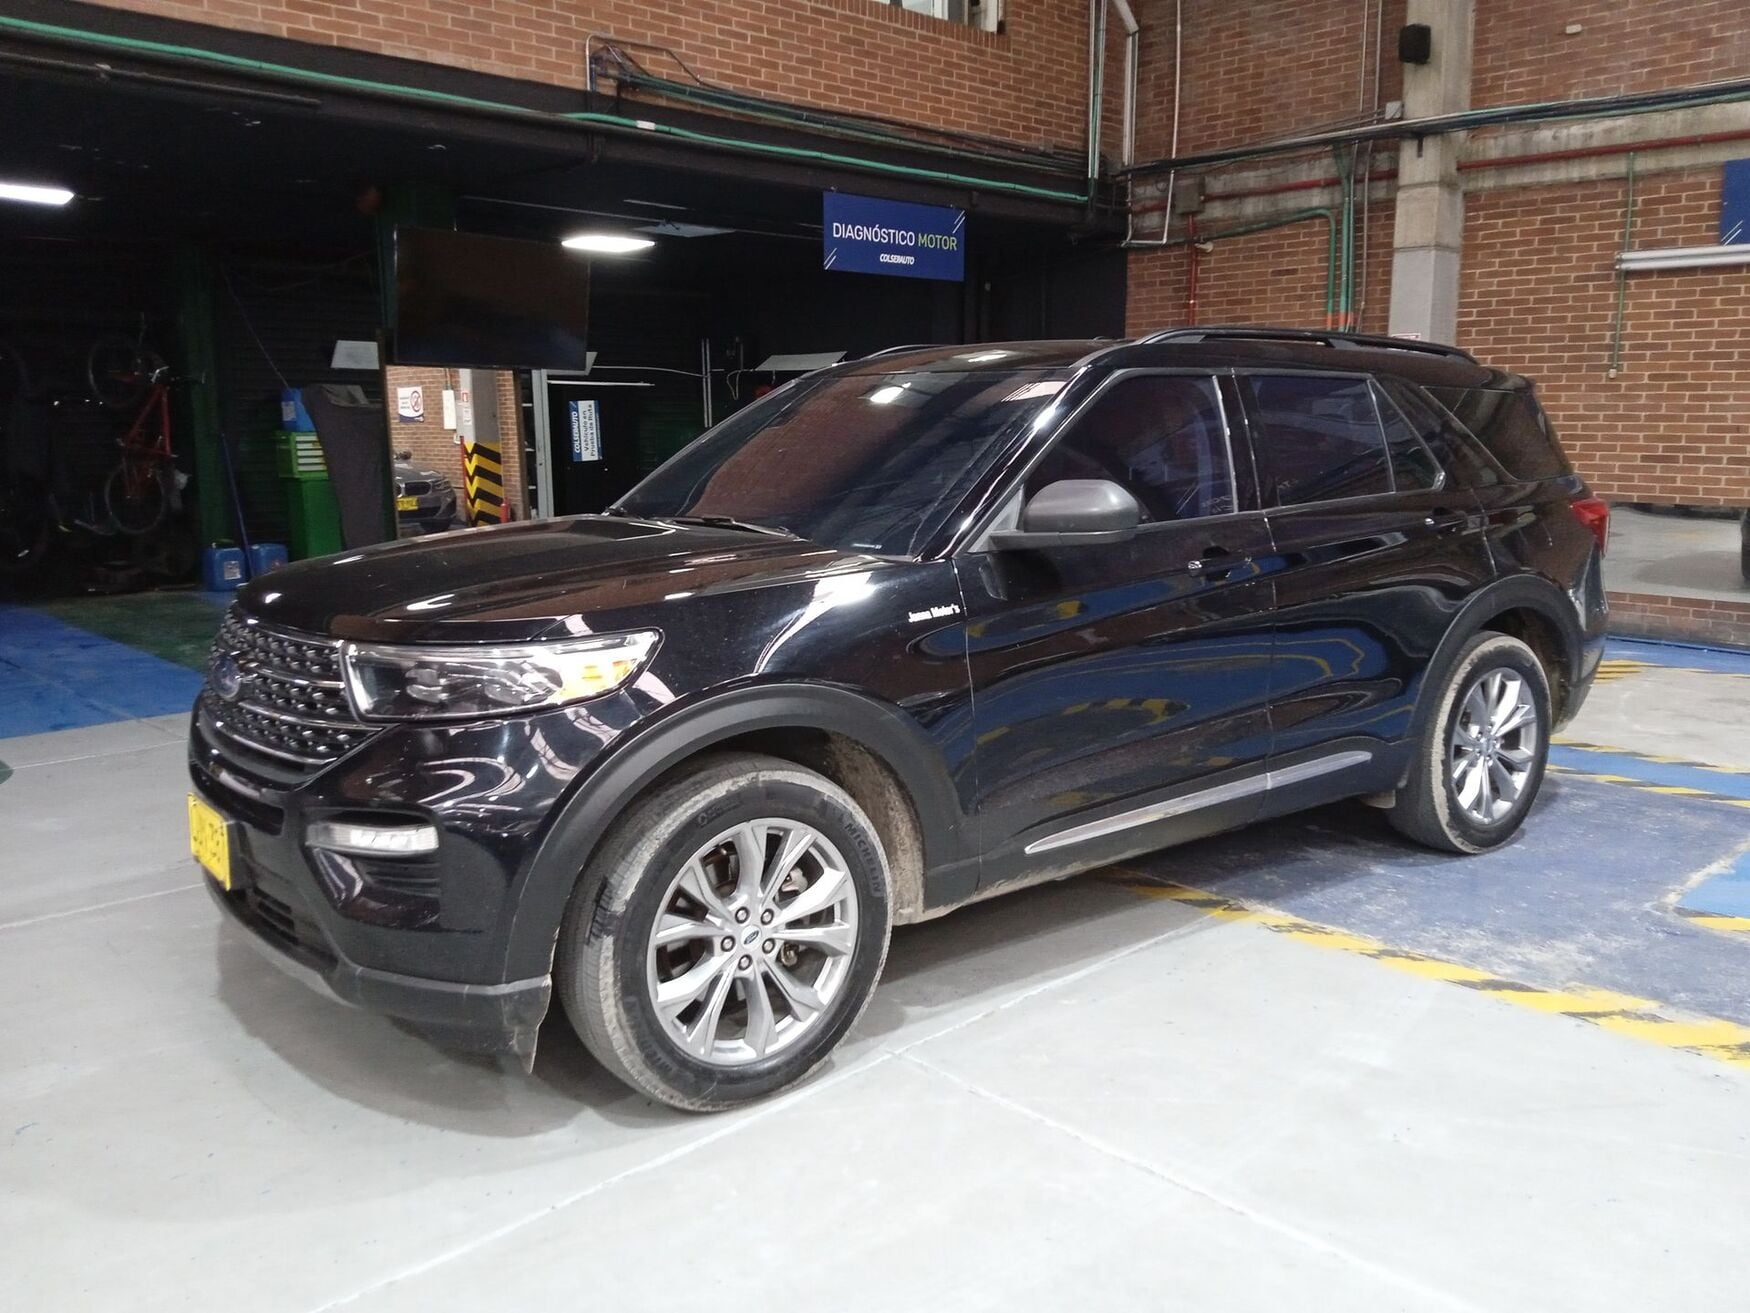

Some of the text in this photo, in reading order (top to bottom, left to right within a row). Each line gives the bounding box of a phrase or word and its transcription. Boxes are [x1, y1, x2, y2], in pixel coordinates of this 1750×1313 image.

[833, 222, 958, 251] DIAGNÓSTICO MOTOR
[844, 823, 881, 893] MICHELIN
